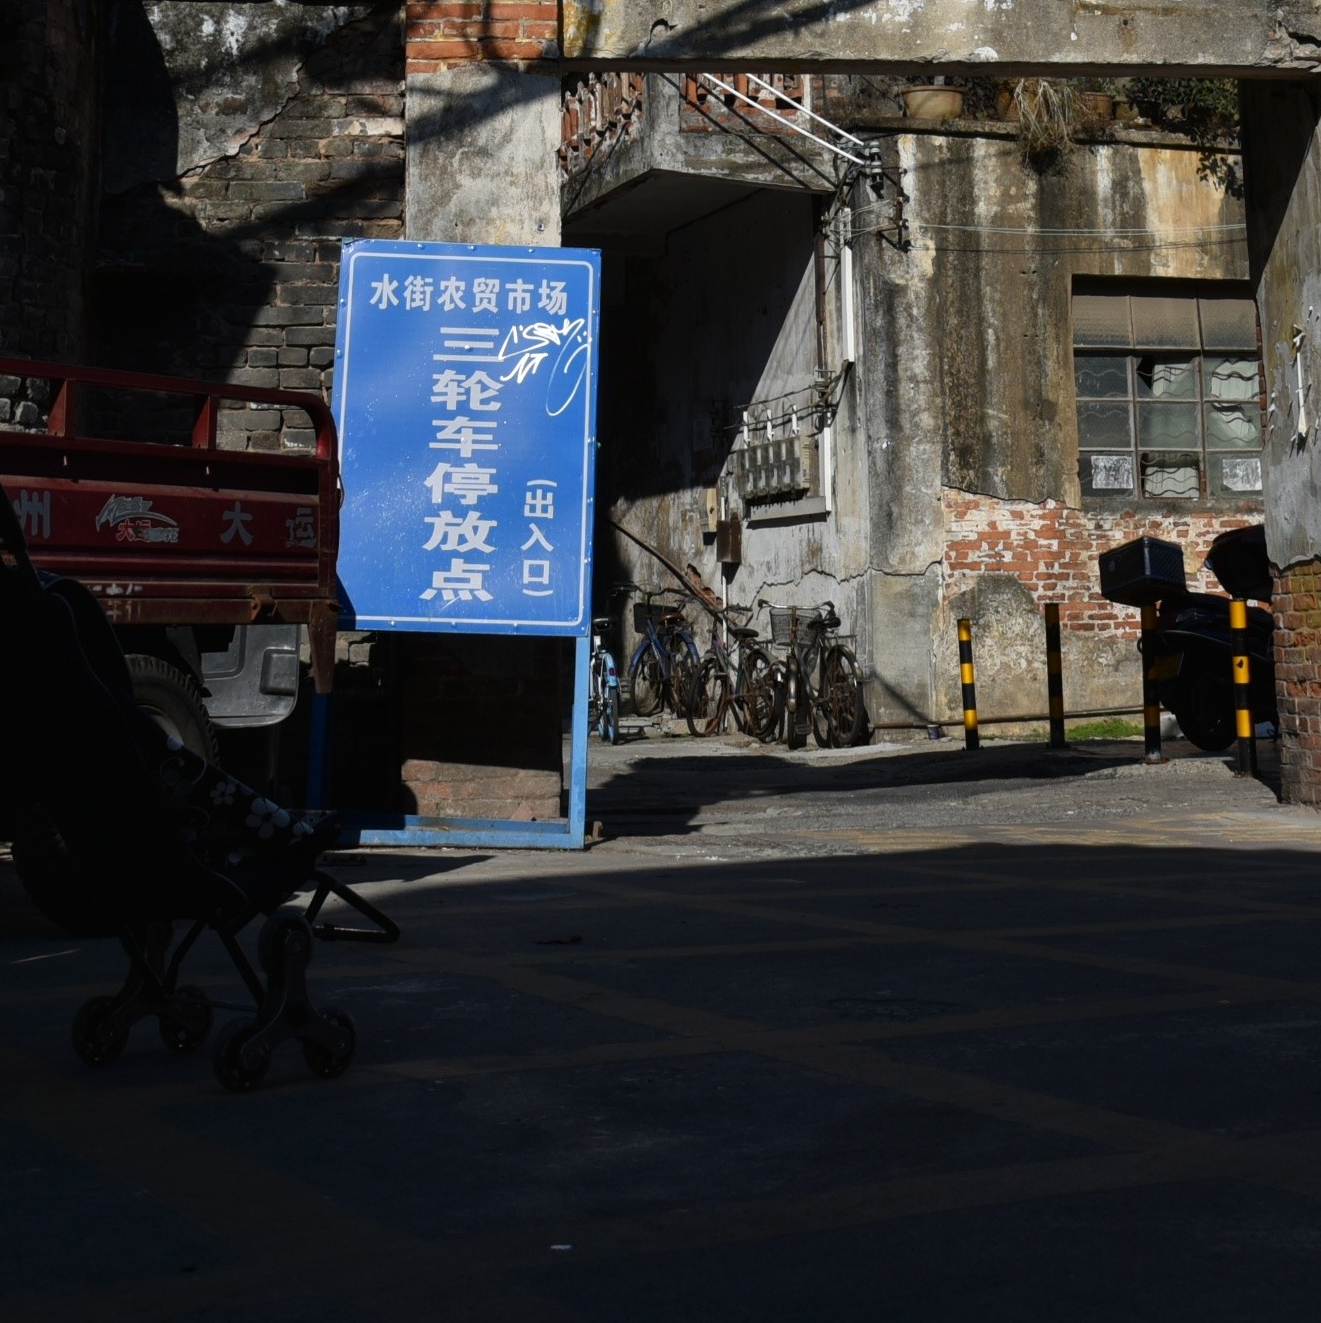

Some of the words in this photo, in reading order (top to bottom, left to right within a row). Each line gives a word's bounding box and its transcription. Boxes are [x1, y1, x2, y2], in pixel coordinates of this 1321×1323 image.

[370, 273, 568, 315] 水街农贸市场
[419, 326, 505, 601] 三轮车停放点
